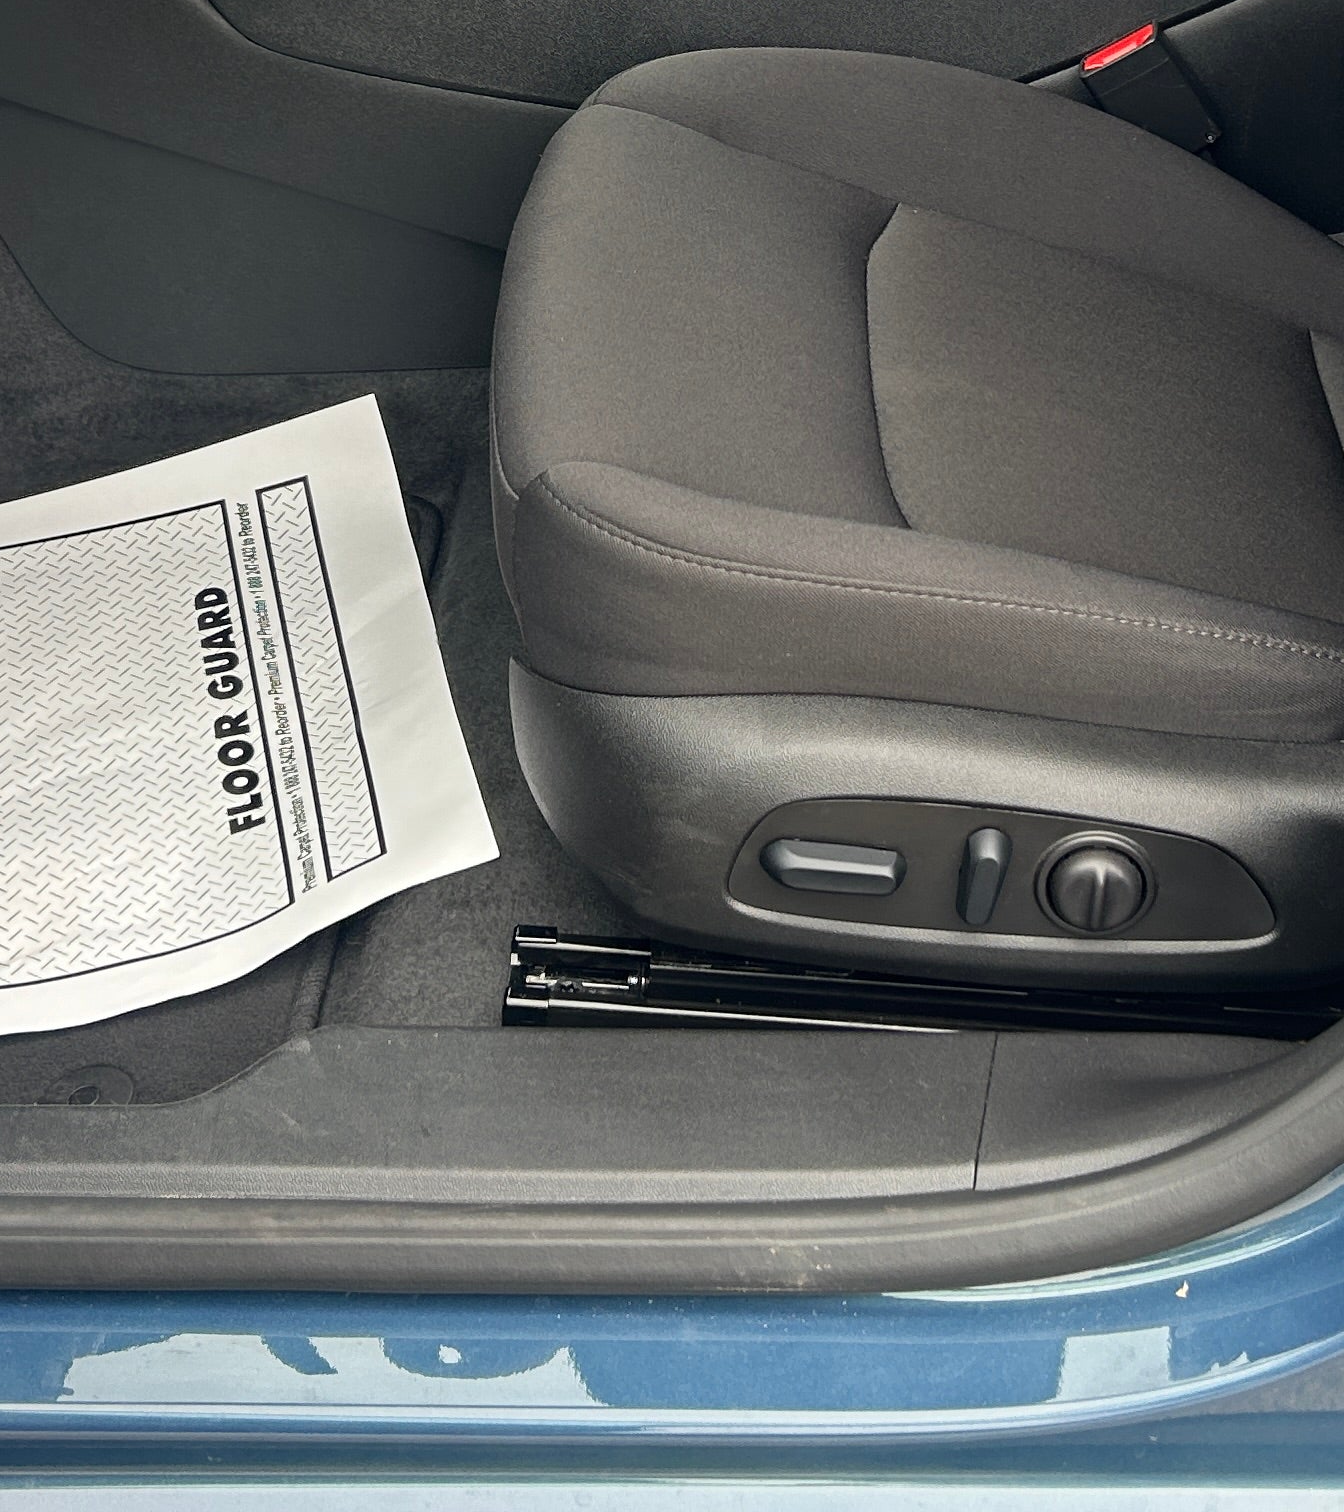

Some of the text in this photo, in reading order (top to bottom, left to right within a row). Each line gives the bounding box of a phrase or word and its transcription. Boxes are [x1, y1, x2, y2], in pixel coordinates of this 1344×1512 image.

[236, 503, 252, 536] Reorder
[242, 538, 255, 546] to
[253, 600, 271, 635] Protection
[260, 638, 277, 660] Carpet
[266, 662, 282, 695] Premium
[195, 587, 266, 835] FLOOR GUARD
[273, 704, 290, 735] Reorder
[279, 737, 293, 745] to
